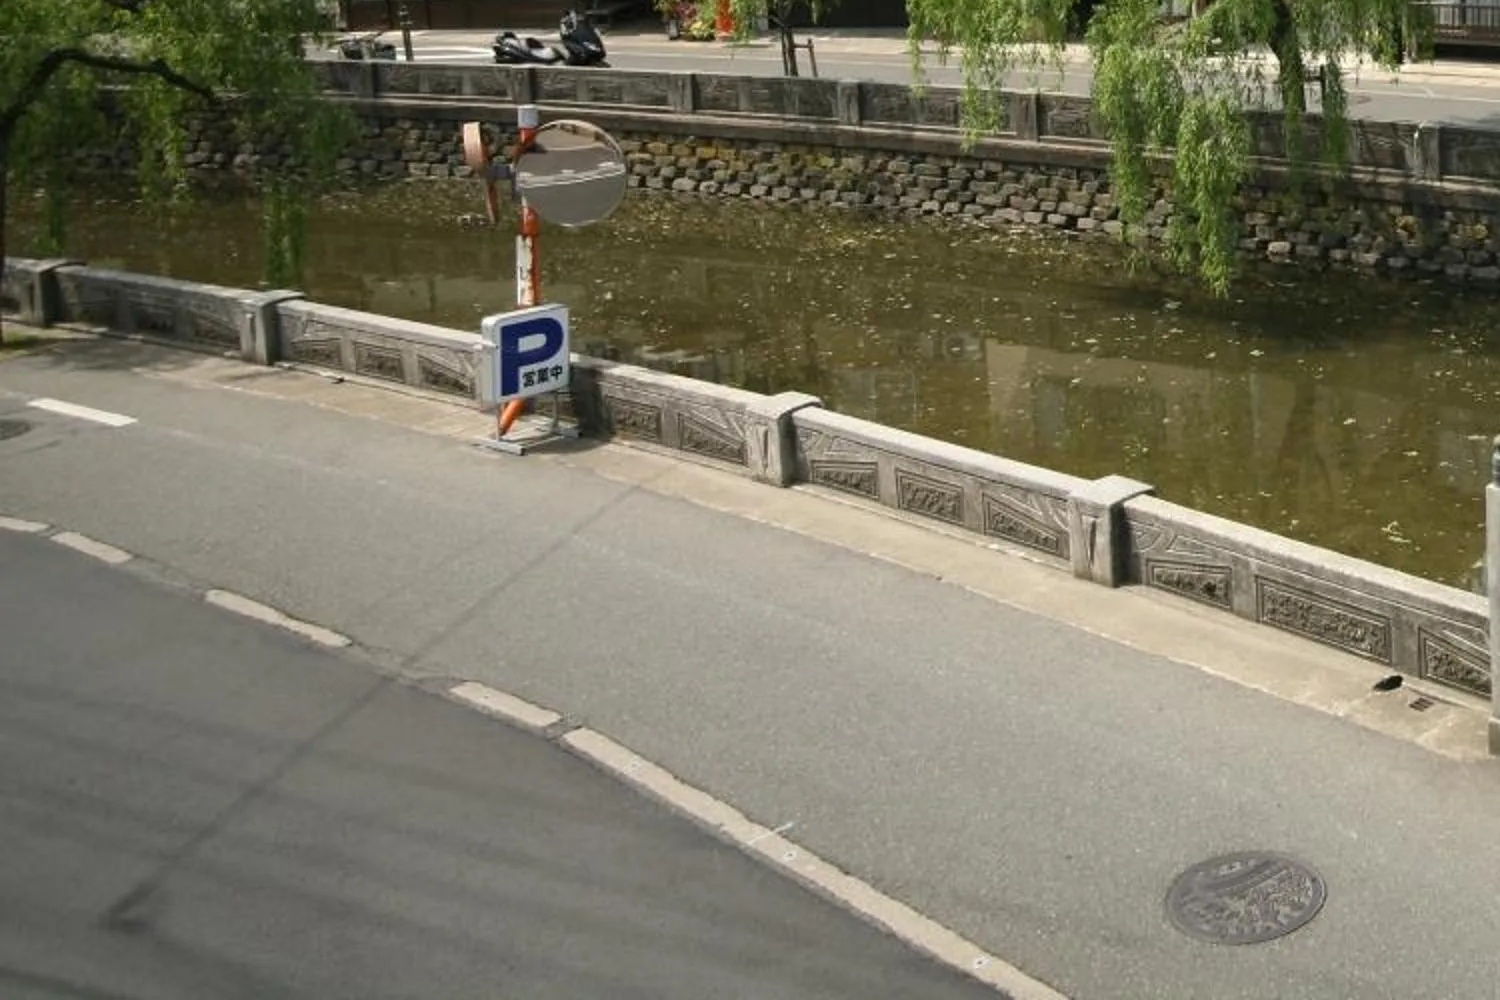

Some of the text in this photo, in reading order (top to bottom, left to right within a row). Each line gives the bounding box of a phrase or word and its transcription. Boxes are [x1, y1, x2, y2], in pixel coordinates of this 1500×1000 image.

[501, 317, 564, 396] P
[522, 365, 563, 388] 営業中
